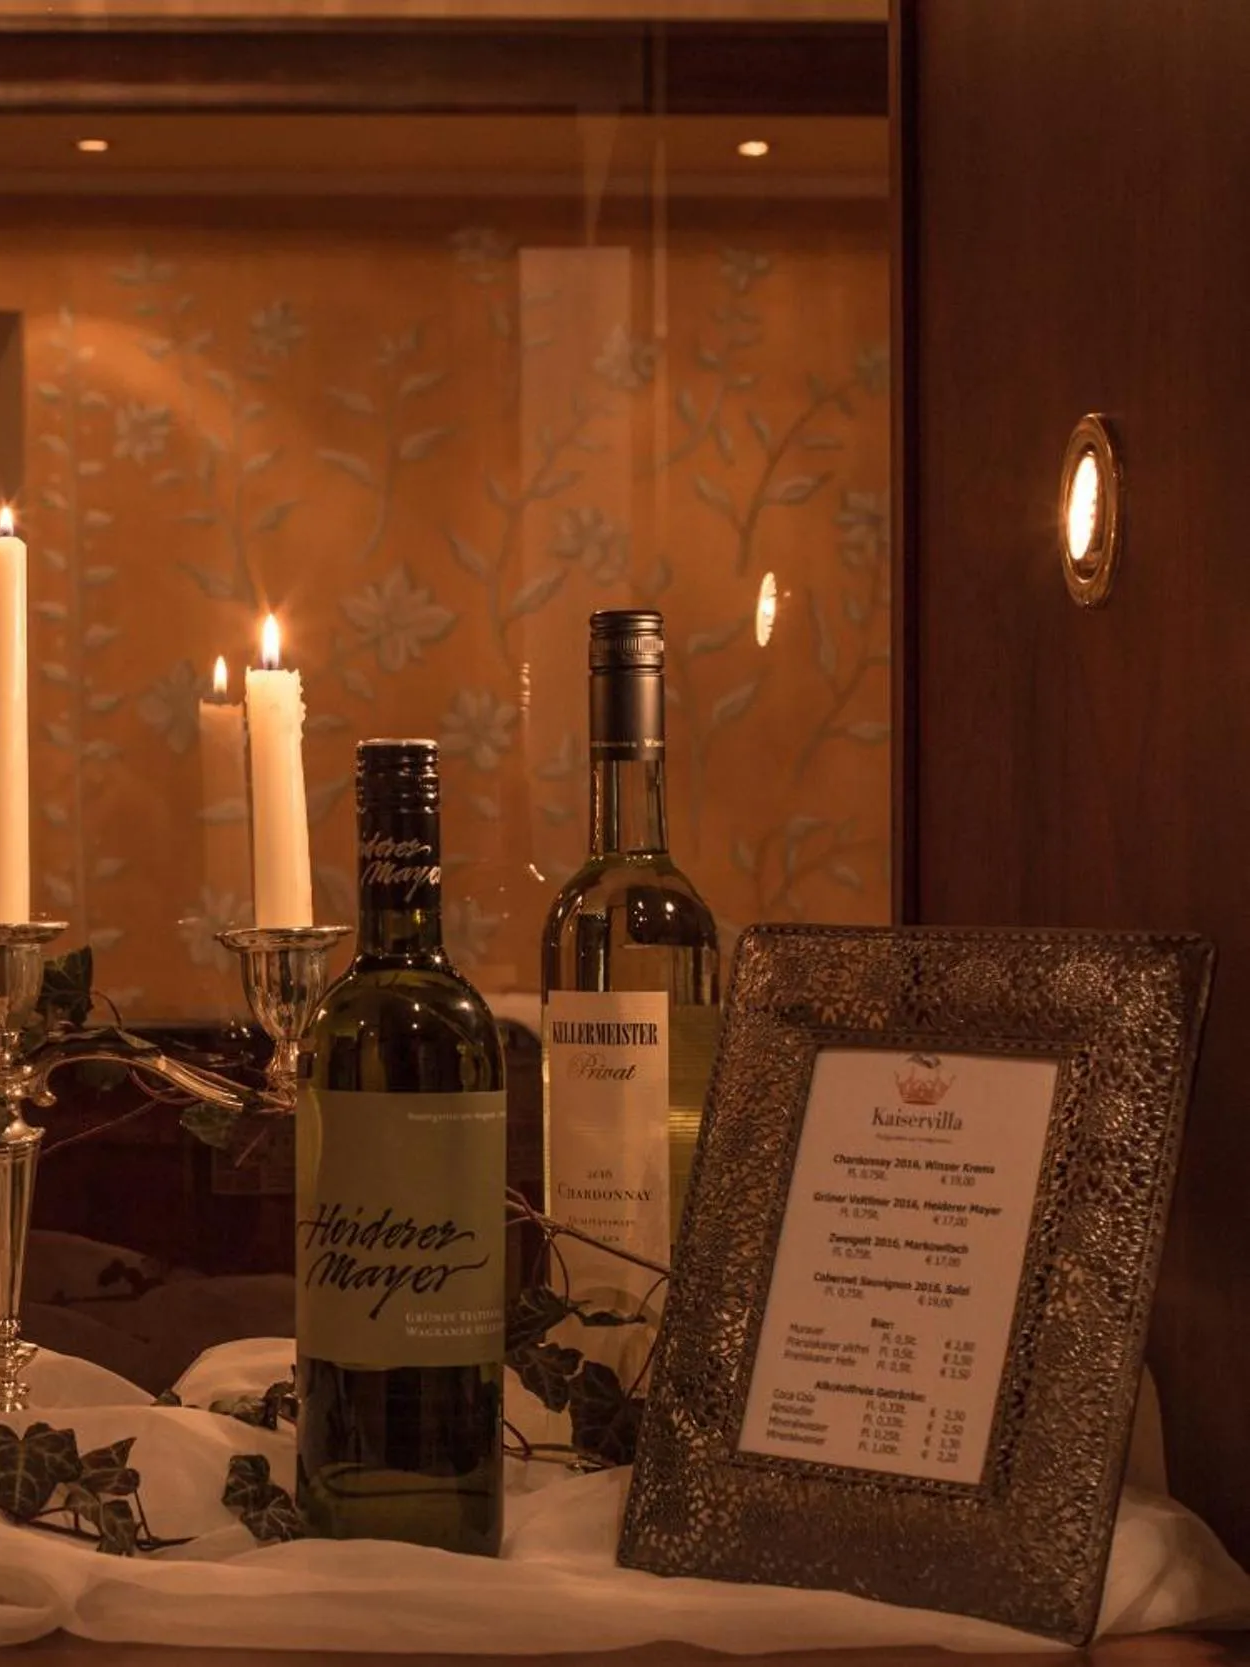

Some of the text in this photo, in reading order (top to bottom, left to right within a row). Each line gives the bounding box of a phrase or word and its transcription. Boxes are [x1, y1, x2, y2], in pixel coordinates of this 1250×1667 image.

[551, 1021, 658, 1045] KELLERMEISTER
[570, 1053, 637, 1081] Privat
[871, 1107, 963, 1132] Kaiservilla
[833, 1154, 891, 1168] Chardonnay
[558, 1183, 652, 1201] CHARDONNAY
[813, 1192, 846, 1203] Grüner
[849, 1195, 890, 1207] Veltliner
[923, 1201, 966, 1212] Heiderer
[969, 1204, 1002, 1217] Mayer
[297, 1203, 475, 1251] Heiderer
[829, 1233, 871, 1246] Zweigelt
[904, 1239, 969, 1254] Markowitsch
[305, 1251, 490, 1320] Mayer
[813, 1272, 857, 1284] Cabernet
[860, 1275, 912, 1290] Sauvignon
[945, 1284, 969, 1296] Salzl
[871, 1317, 895, 1329] Bier:
[773, 1388, 795, 1401] Coca
[796, 1391, 816, 1403] Cola
[814, 1380, 874, 1396] Alkoholfreie
[768, 1416, 829, 1431] Mineralwasser
[766, 1429, 825, 1445] Mineralwasser
